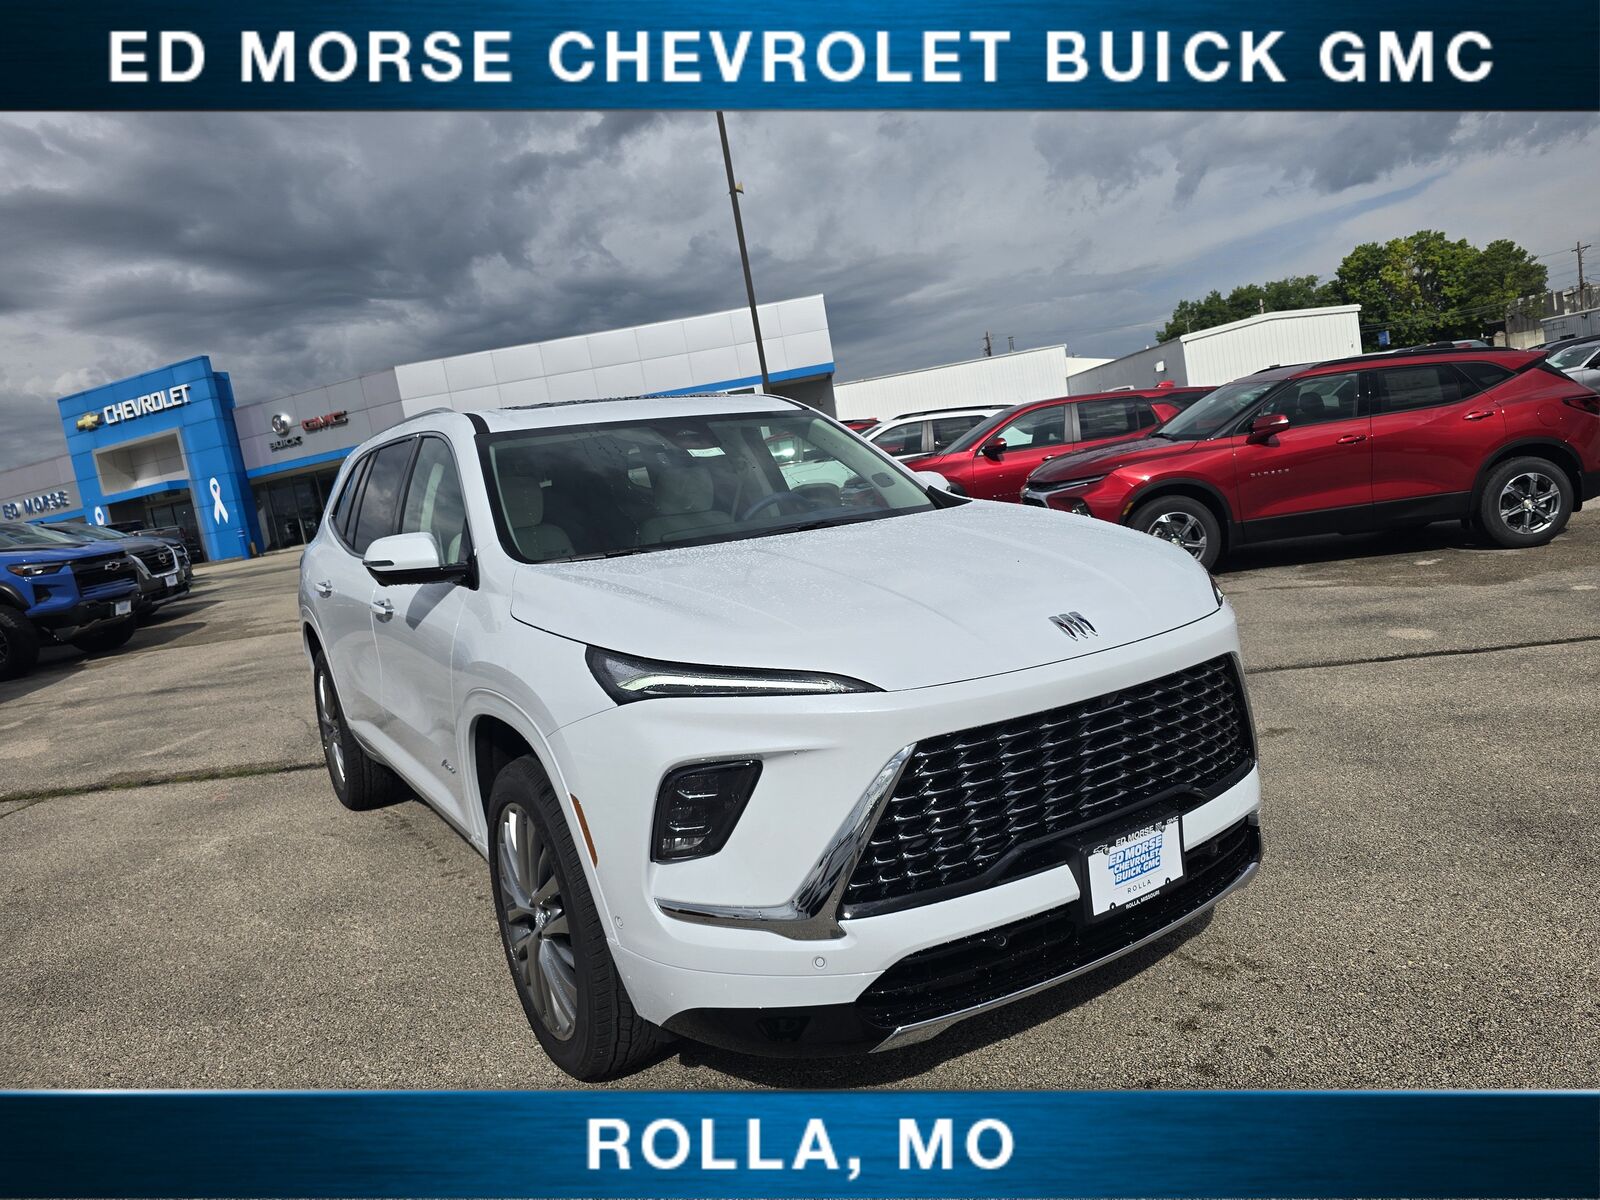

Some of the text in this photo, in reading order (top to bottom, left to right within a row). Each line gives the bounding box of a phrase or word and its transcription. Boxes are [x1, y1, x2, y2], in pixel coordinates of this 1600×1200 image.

[103, 384, 190, 424] CHEVROLET
[301, 411, 348, 433] GMC
[270, 436, 302, 452] BUICK
[2, 491, 70, 519] ED MORSE
[1115, 825, 1154, 847] ED MORSE
[1108, 836, 1162, 867] ED MORSE
[1127, 879, 1151, 894] ROLLA
